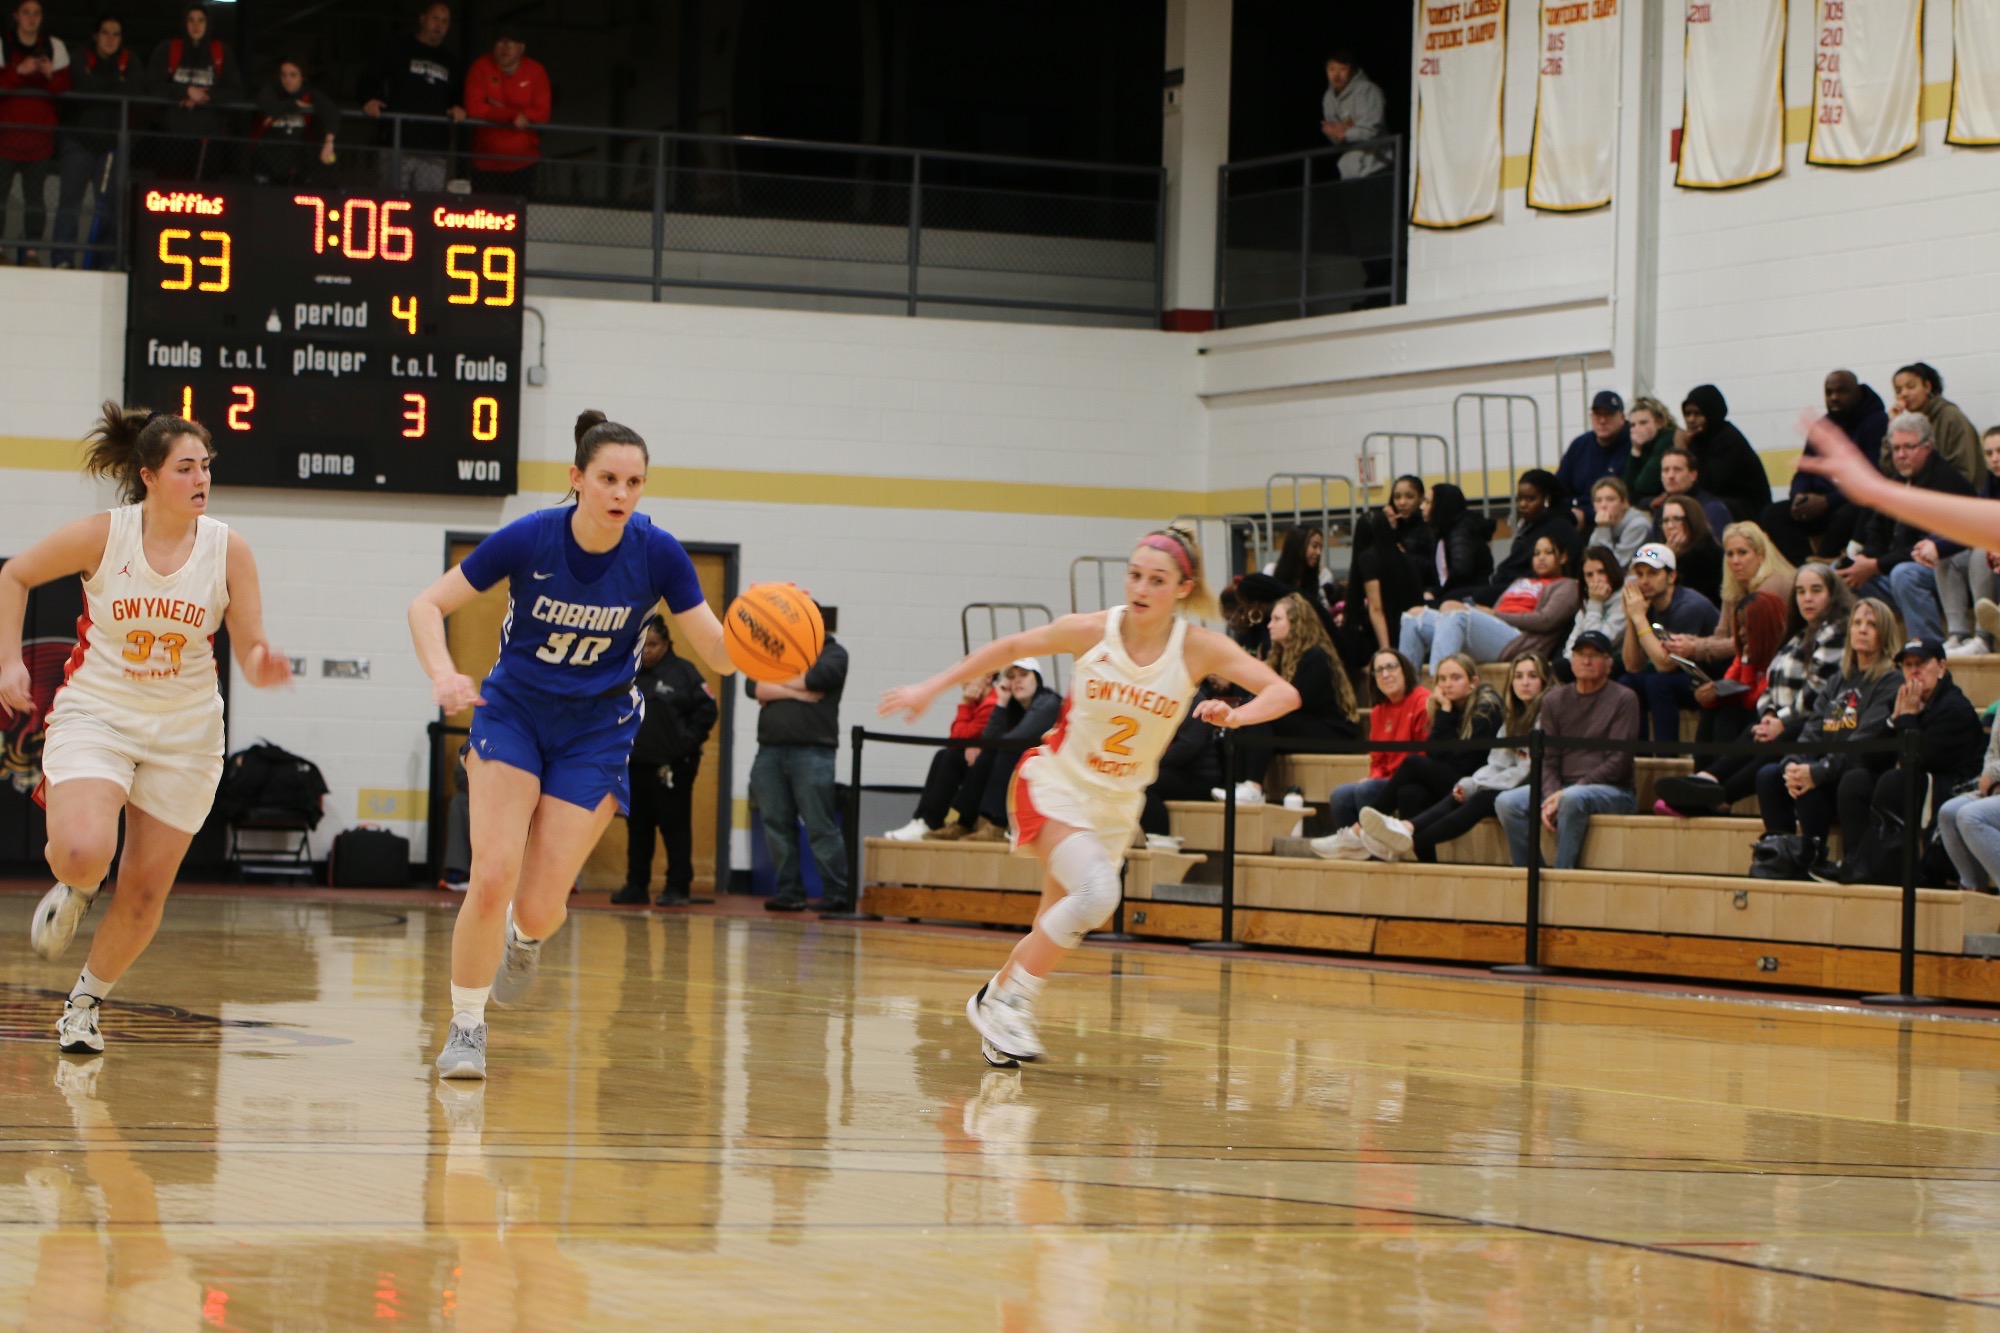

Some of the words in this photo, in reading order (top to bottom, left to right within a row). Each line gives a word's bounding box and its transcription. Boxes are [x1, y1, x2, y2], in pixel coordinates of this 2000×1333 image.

[146, 191, 224, 216] Griffins
[433, 207, 516, 231] Cavaliers
[294, 195, 414, 262] 7:06
[158, 229, 231, 292] 53
[446, 244, 516, 307] 59
[294, 302, 368, 329] period
[391, 295, 418, 335] 4
[148, 338, 202, 368] fouls
[293, 344, 367, 378] player
[455, 353, 508, 382] fouls
[182, 385, 193, 422] 1
[228, 385, 255, 430] 2
[402, 393, 427, 438] 3
[472, 396, 498, 441] 0
[298, 452, 355, 479] game
[457, 459, 501, 481] won
[112, 597, 206, 628] GWYNEDD
[531, 594, 633, 632] CABRINI
[122, 629, 188, 668] 33
[1086, 679, 1180, 719] GWYNEDD
[1103, 715, 1143, 756] 2
